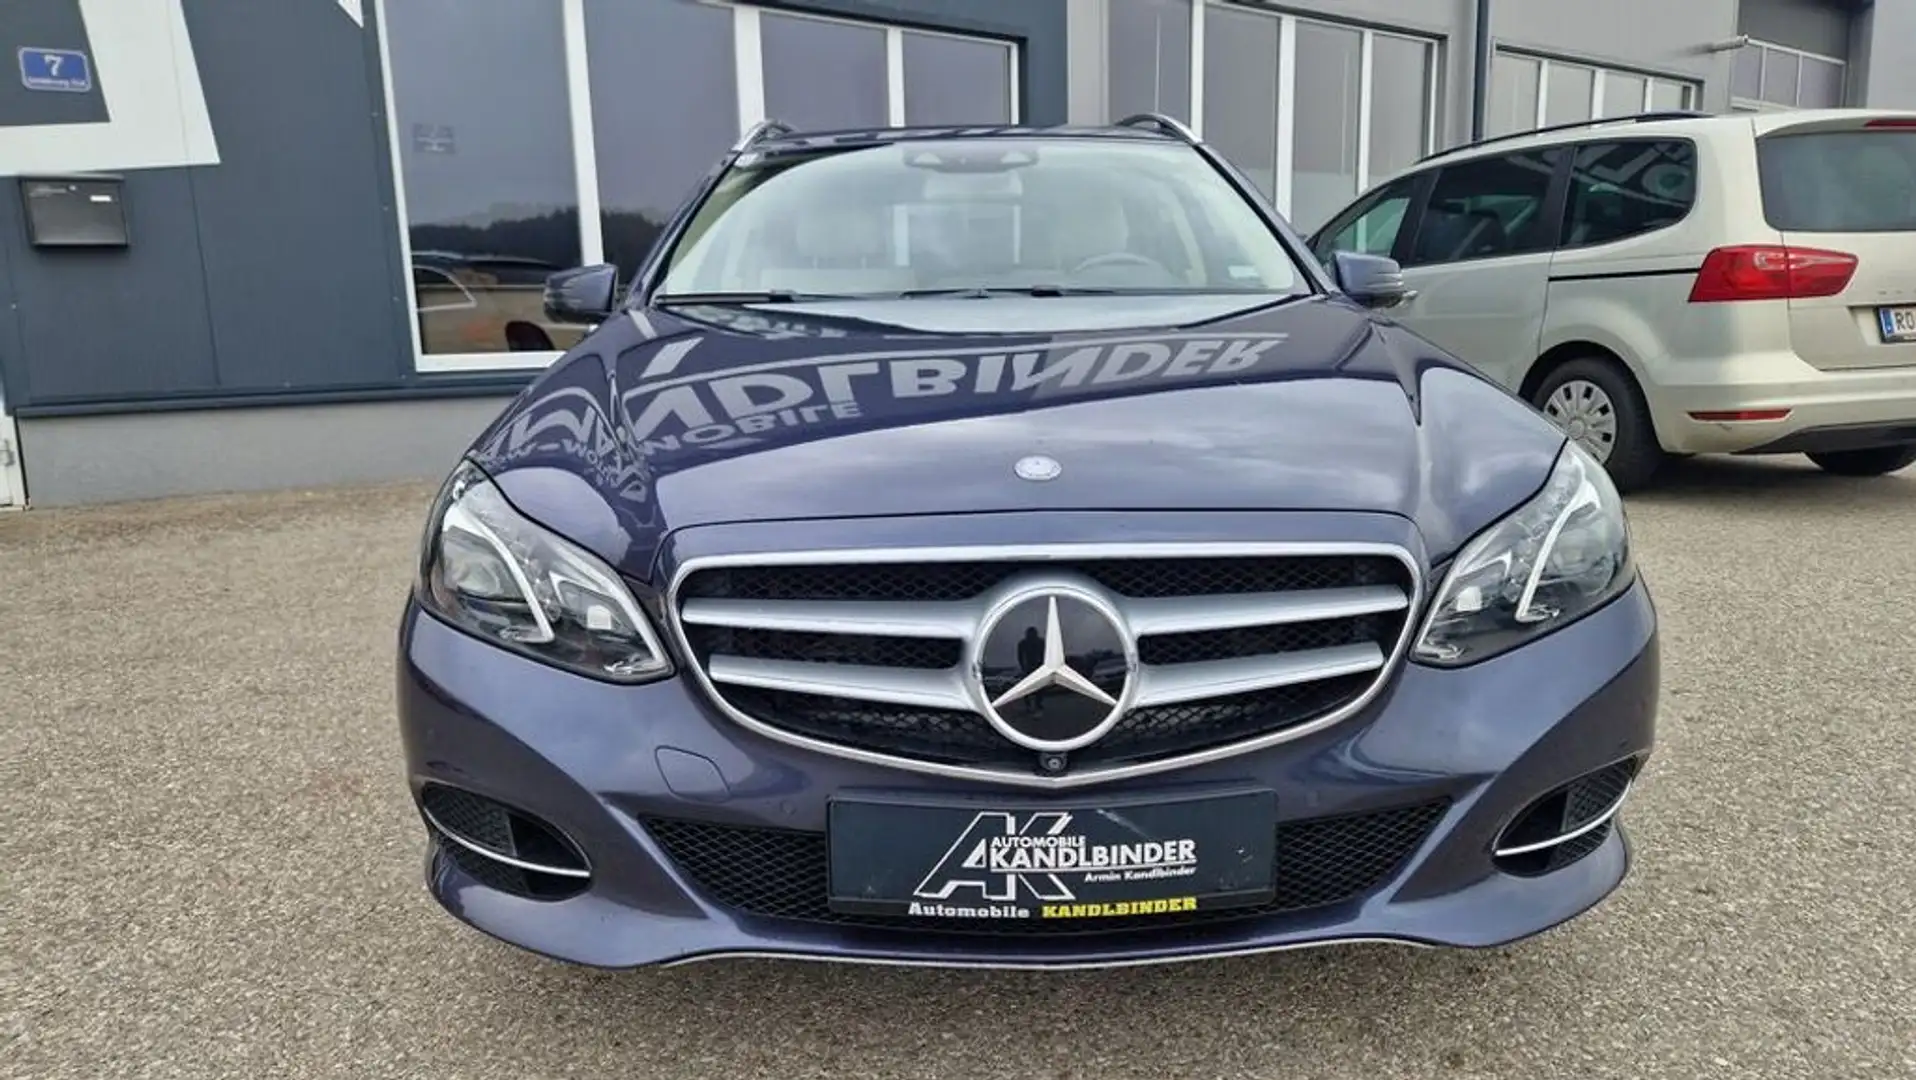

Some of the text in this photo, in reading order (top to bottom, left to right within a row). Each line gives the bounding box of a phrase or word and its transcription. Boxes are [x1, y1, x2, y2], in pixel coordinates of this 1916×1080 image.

[44, 54, 64, 76] 7
[990, 835, 1086, 848] AUTOMOBILE
[990, 839, 1196, 869] KANDLBINDER
[1084, 866, 1197, 883] Armin Kandlbinder
[908, 896, 1197, 919] Automobile KANDLBINDER
